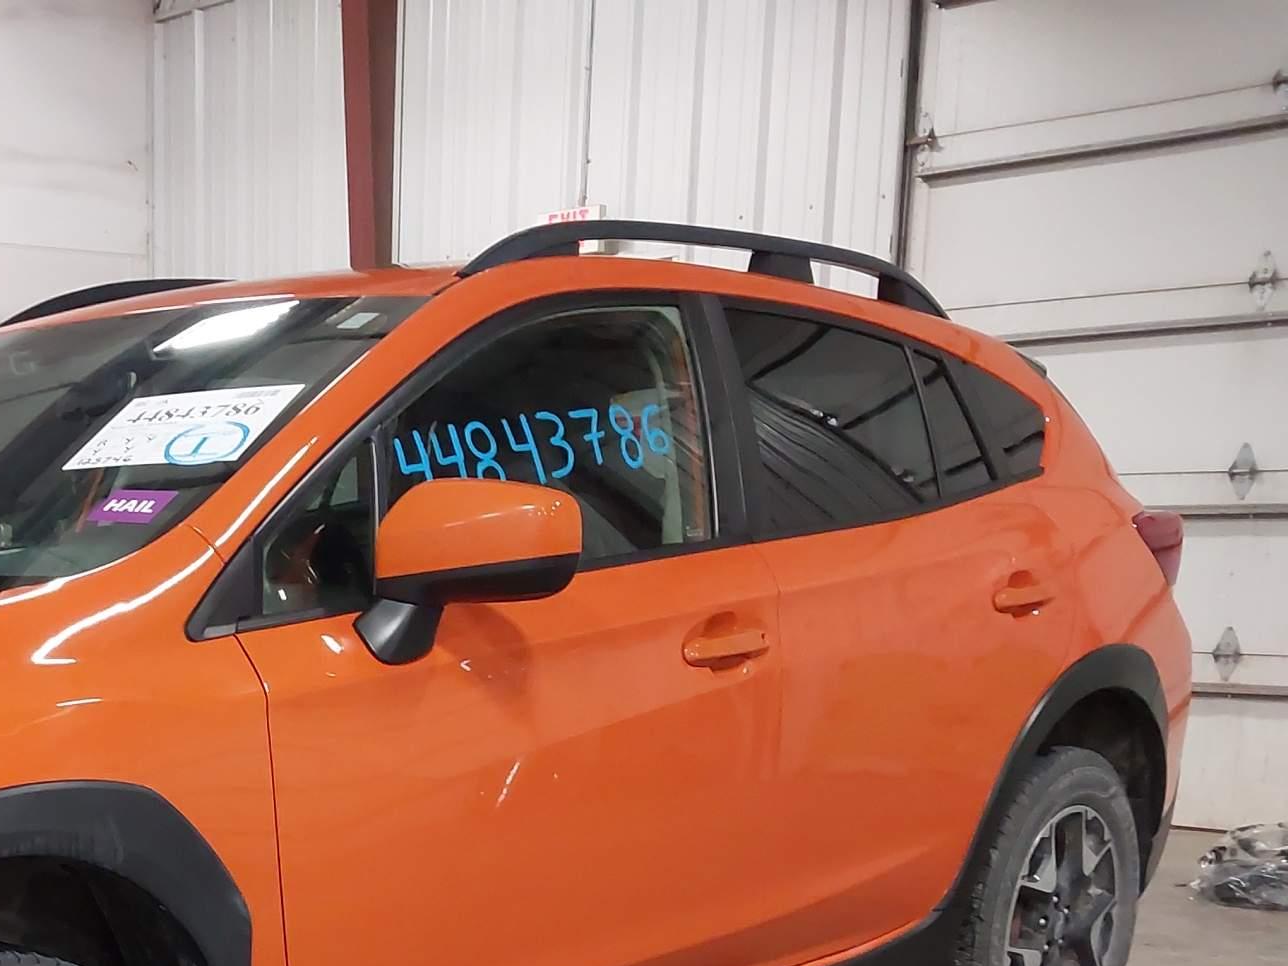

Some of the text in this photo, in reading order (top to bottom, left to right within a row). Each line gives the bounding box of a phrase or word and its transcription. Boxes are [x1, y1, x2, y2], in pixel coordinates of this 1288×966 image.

[127, 402, 261, 423] 44843786
[394, 404, 671, 484] 44843786
[103, 499, 156, 514] HAIL
